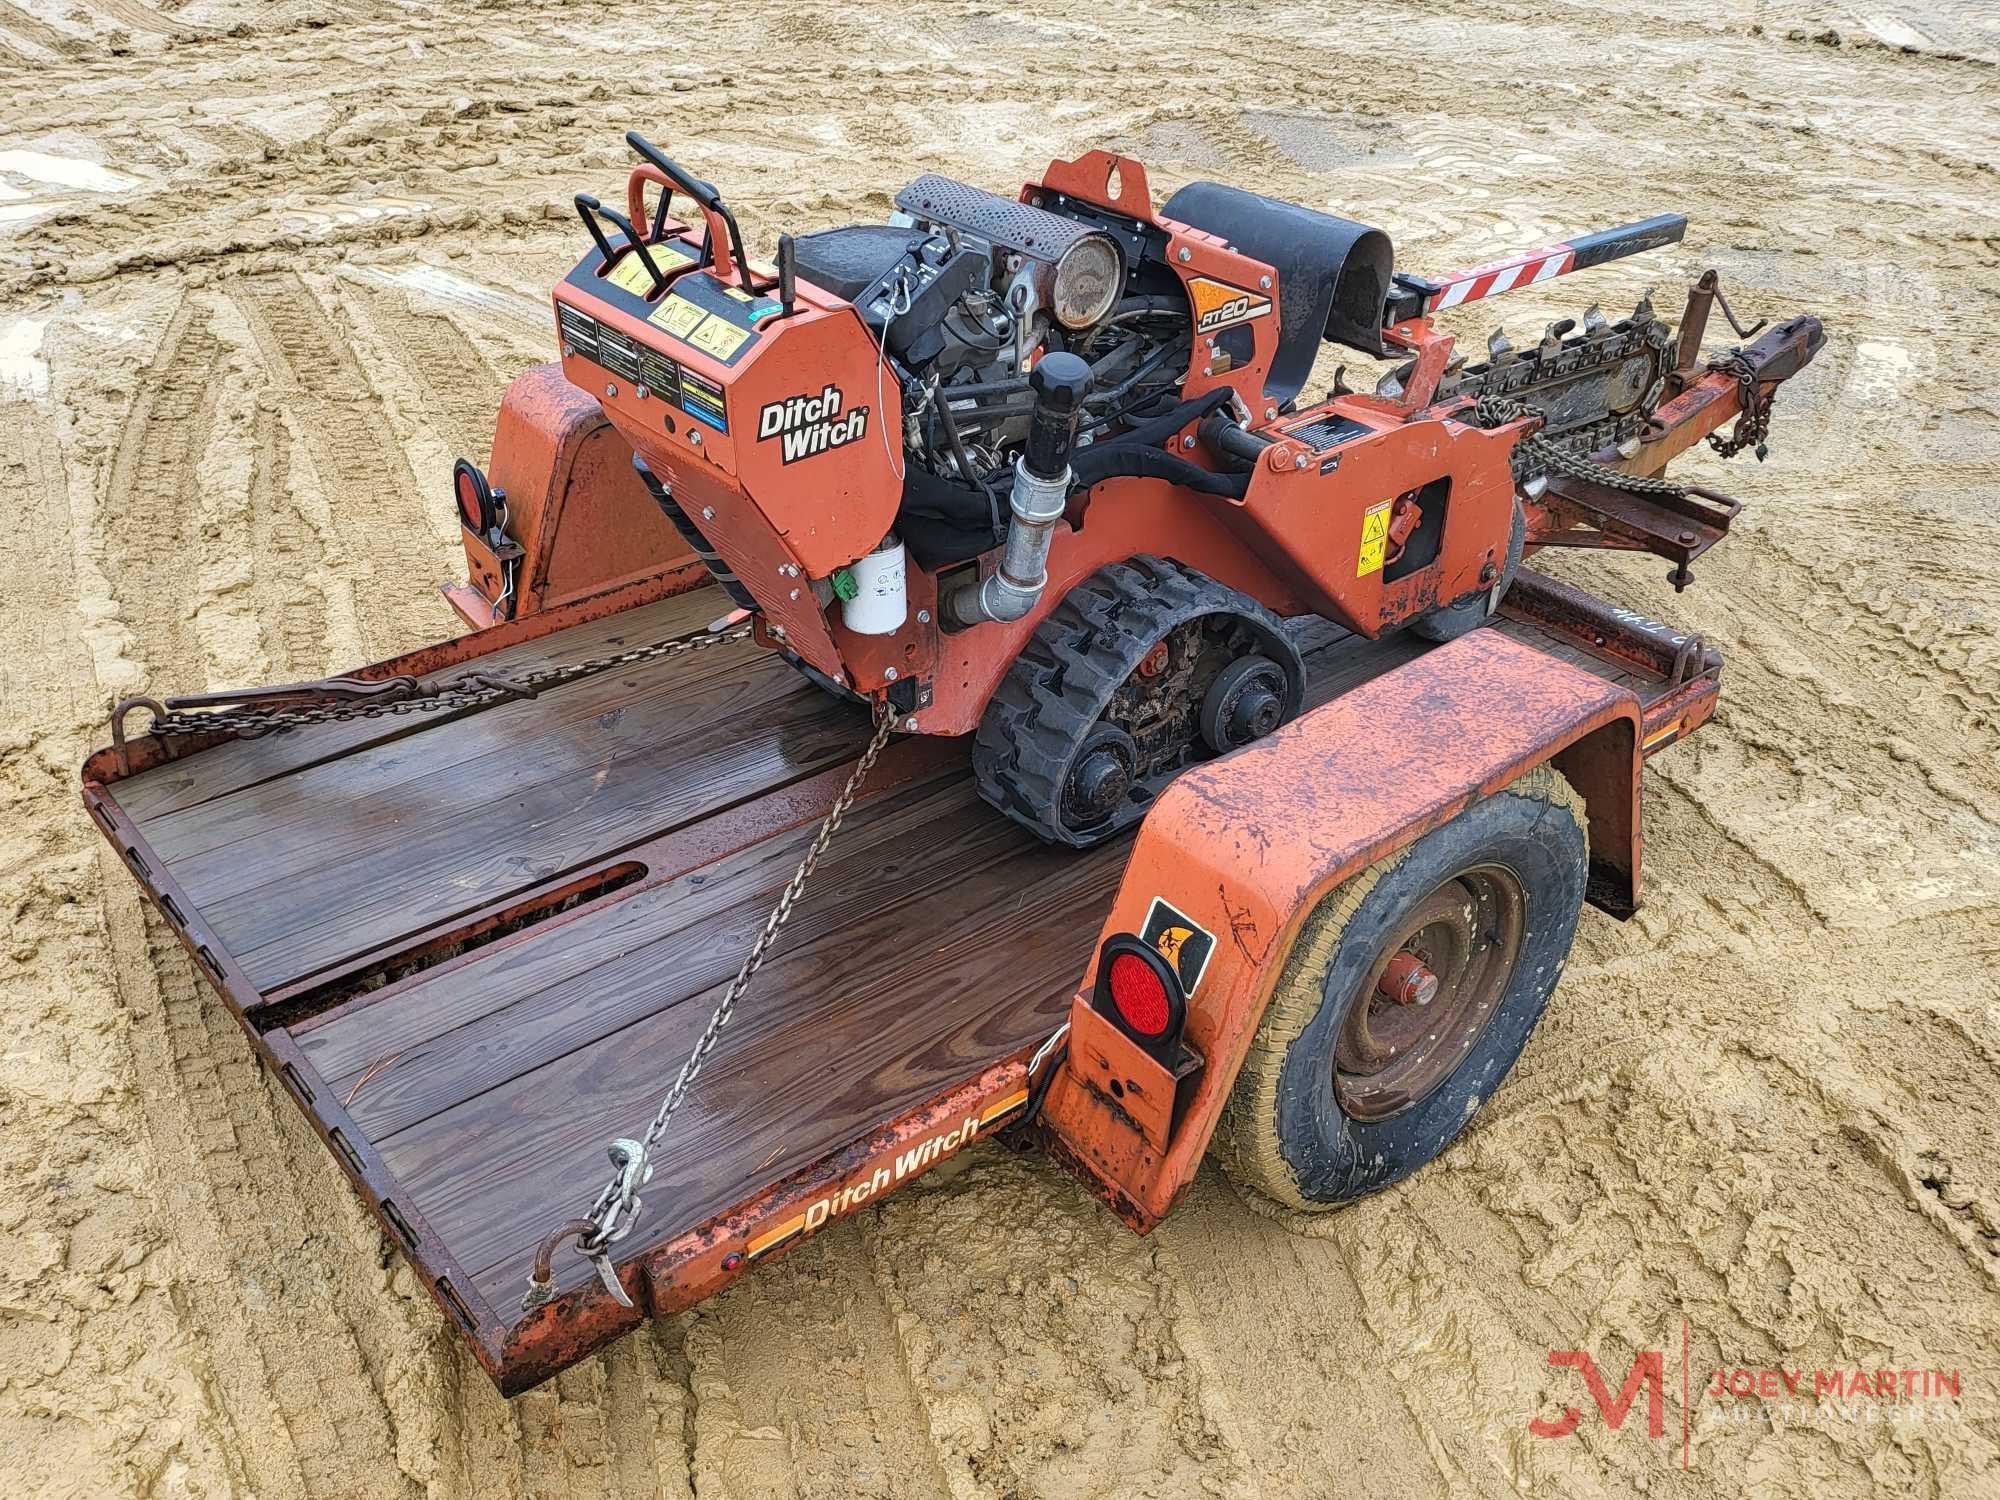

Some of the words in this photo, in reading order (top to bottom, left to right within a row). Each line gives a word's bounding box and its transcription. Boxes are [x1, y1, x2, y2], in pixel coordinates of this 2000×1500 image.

[1202, 297, 1249, 327] RT20
[760, 387, 841, 438] Ditch
[784, 410, 867, 462] Witch
[803, 1167, 890, 1232] Ditch
[894, 1117, 980, 1181] Witch
